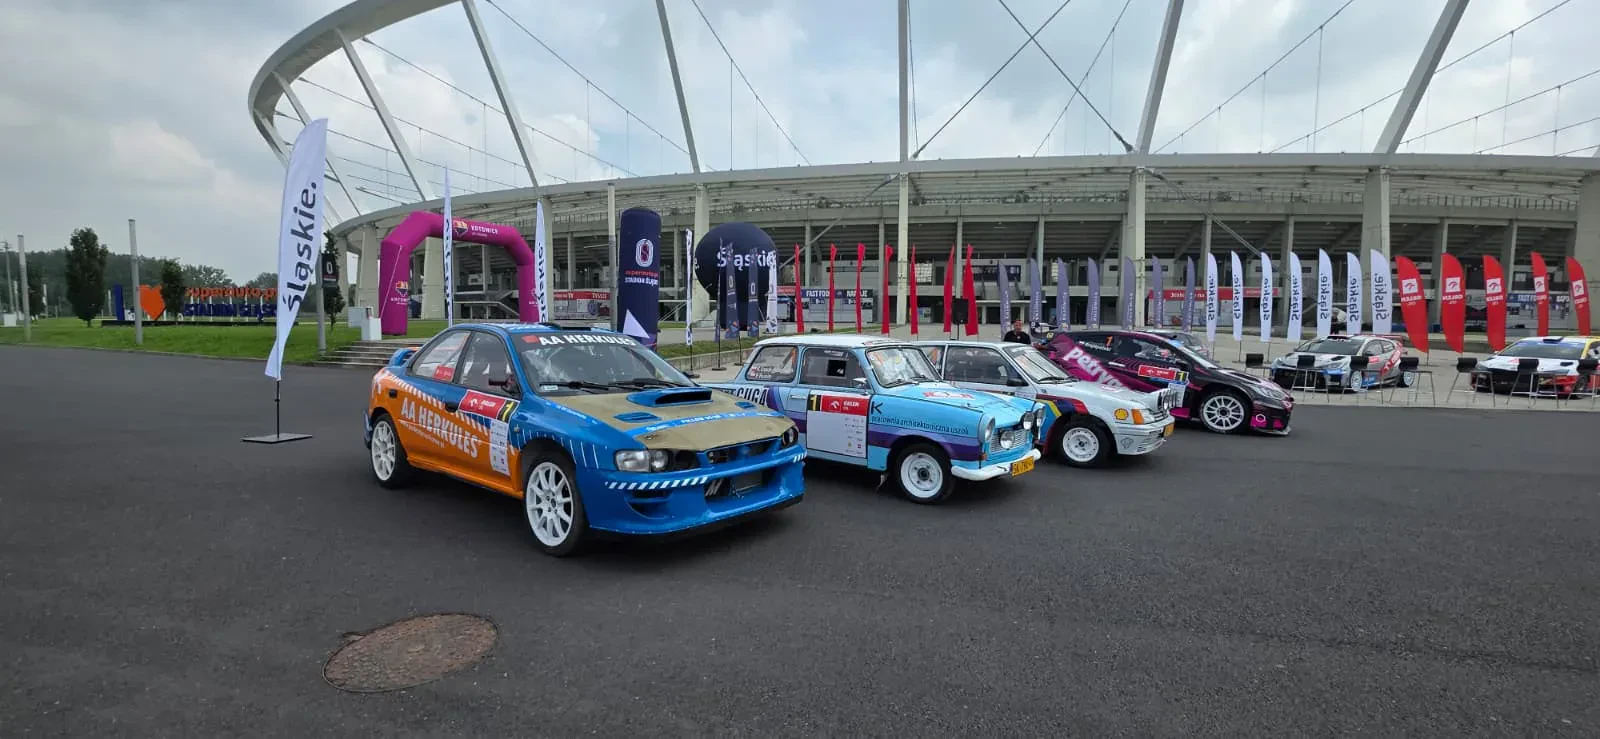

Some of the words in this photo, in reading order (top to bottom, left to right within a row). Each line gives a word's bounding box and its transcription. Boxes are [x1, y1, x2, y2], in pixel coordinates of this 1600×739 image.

[282, 181, 317, 312] Śląskie.
[539, 335, 565, 346] AA
[562, 334, 636, 346] HERKULES
[502, 401, 515, 421] 1
[810, 396, 818, 412] 1
[401, 397, 416, 423] AA
[419, 405, 478, 459] HERKULES
